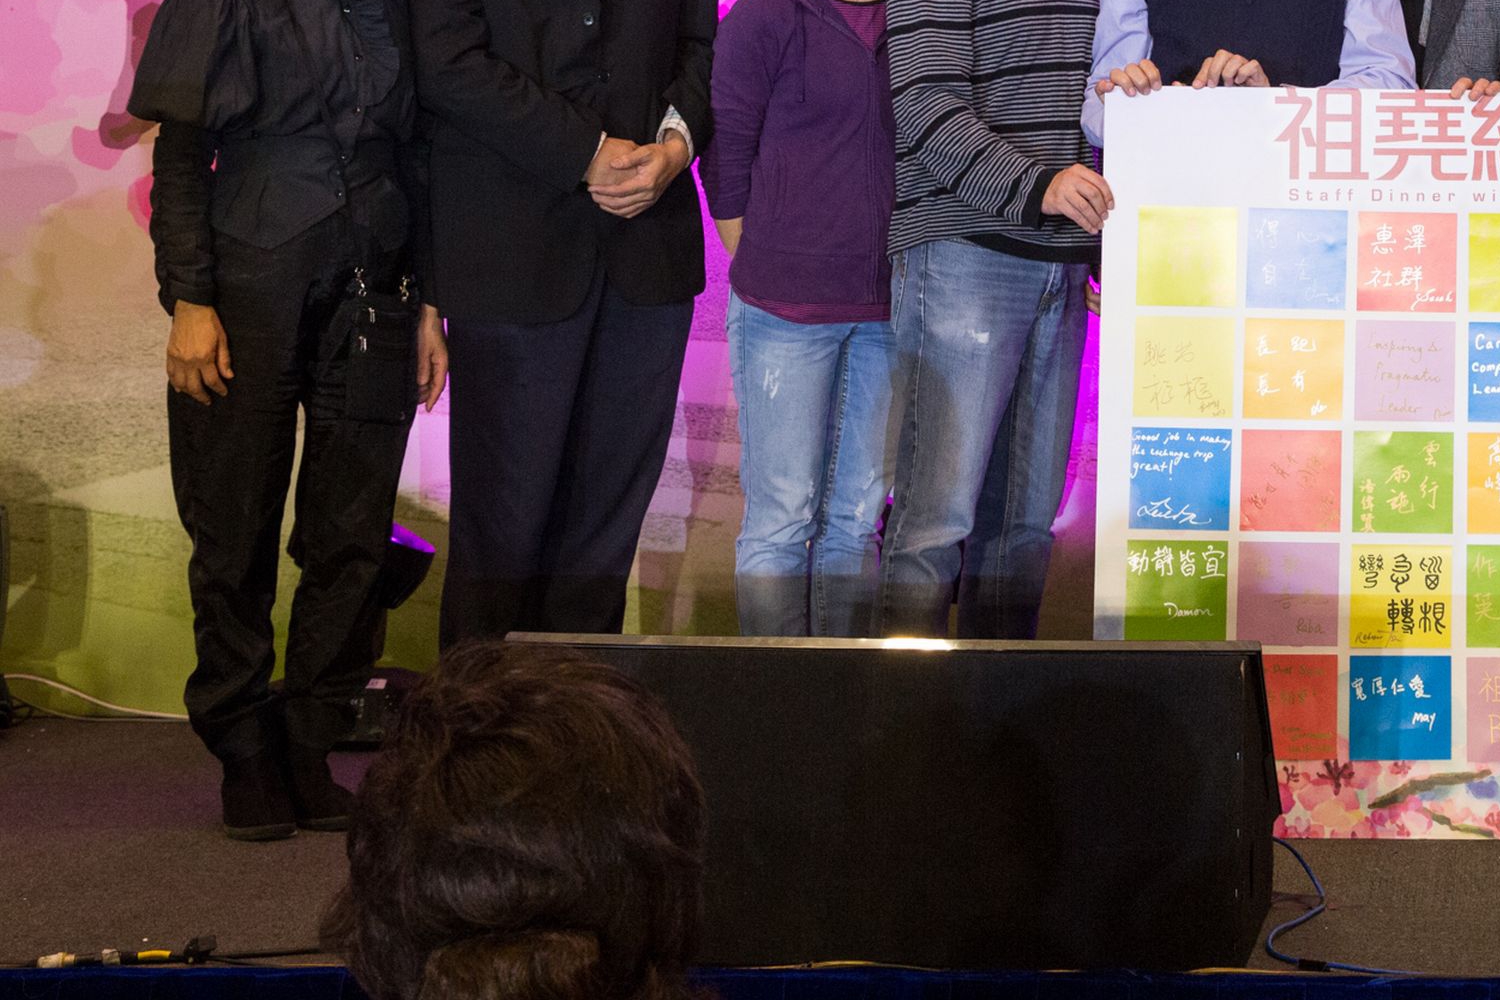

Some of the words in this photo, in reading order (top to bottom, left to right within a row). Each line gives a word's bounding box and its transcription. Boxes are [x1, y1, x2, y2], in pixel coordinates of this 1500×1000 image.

[1288, 187, 1354, 202] Staff
[1371, 188, 1456, 203] Dinner
[1364, 265, 1425, 292] 社群
[1126, 544, 1227, 581] 動靜皆宜
